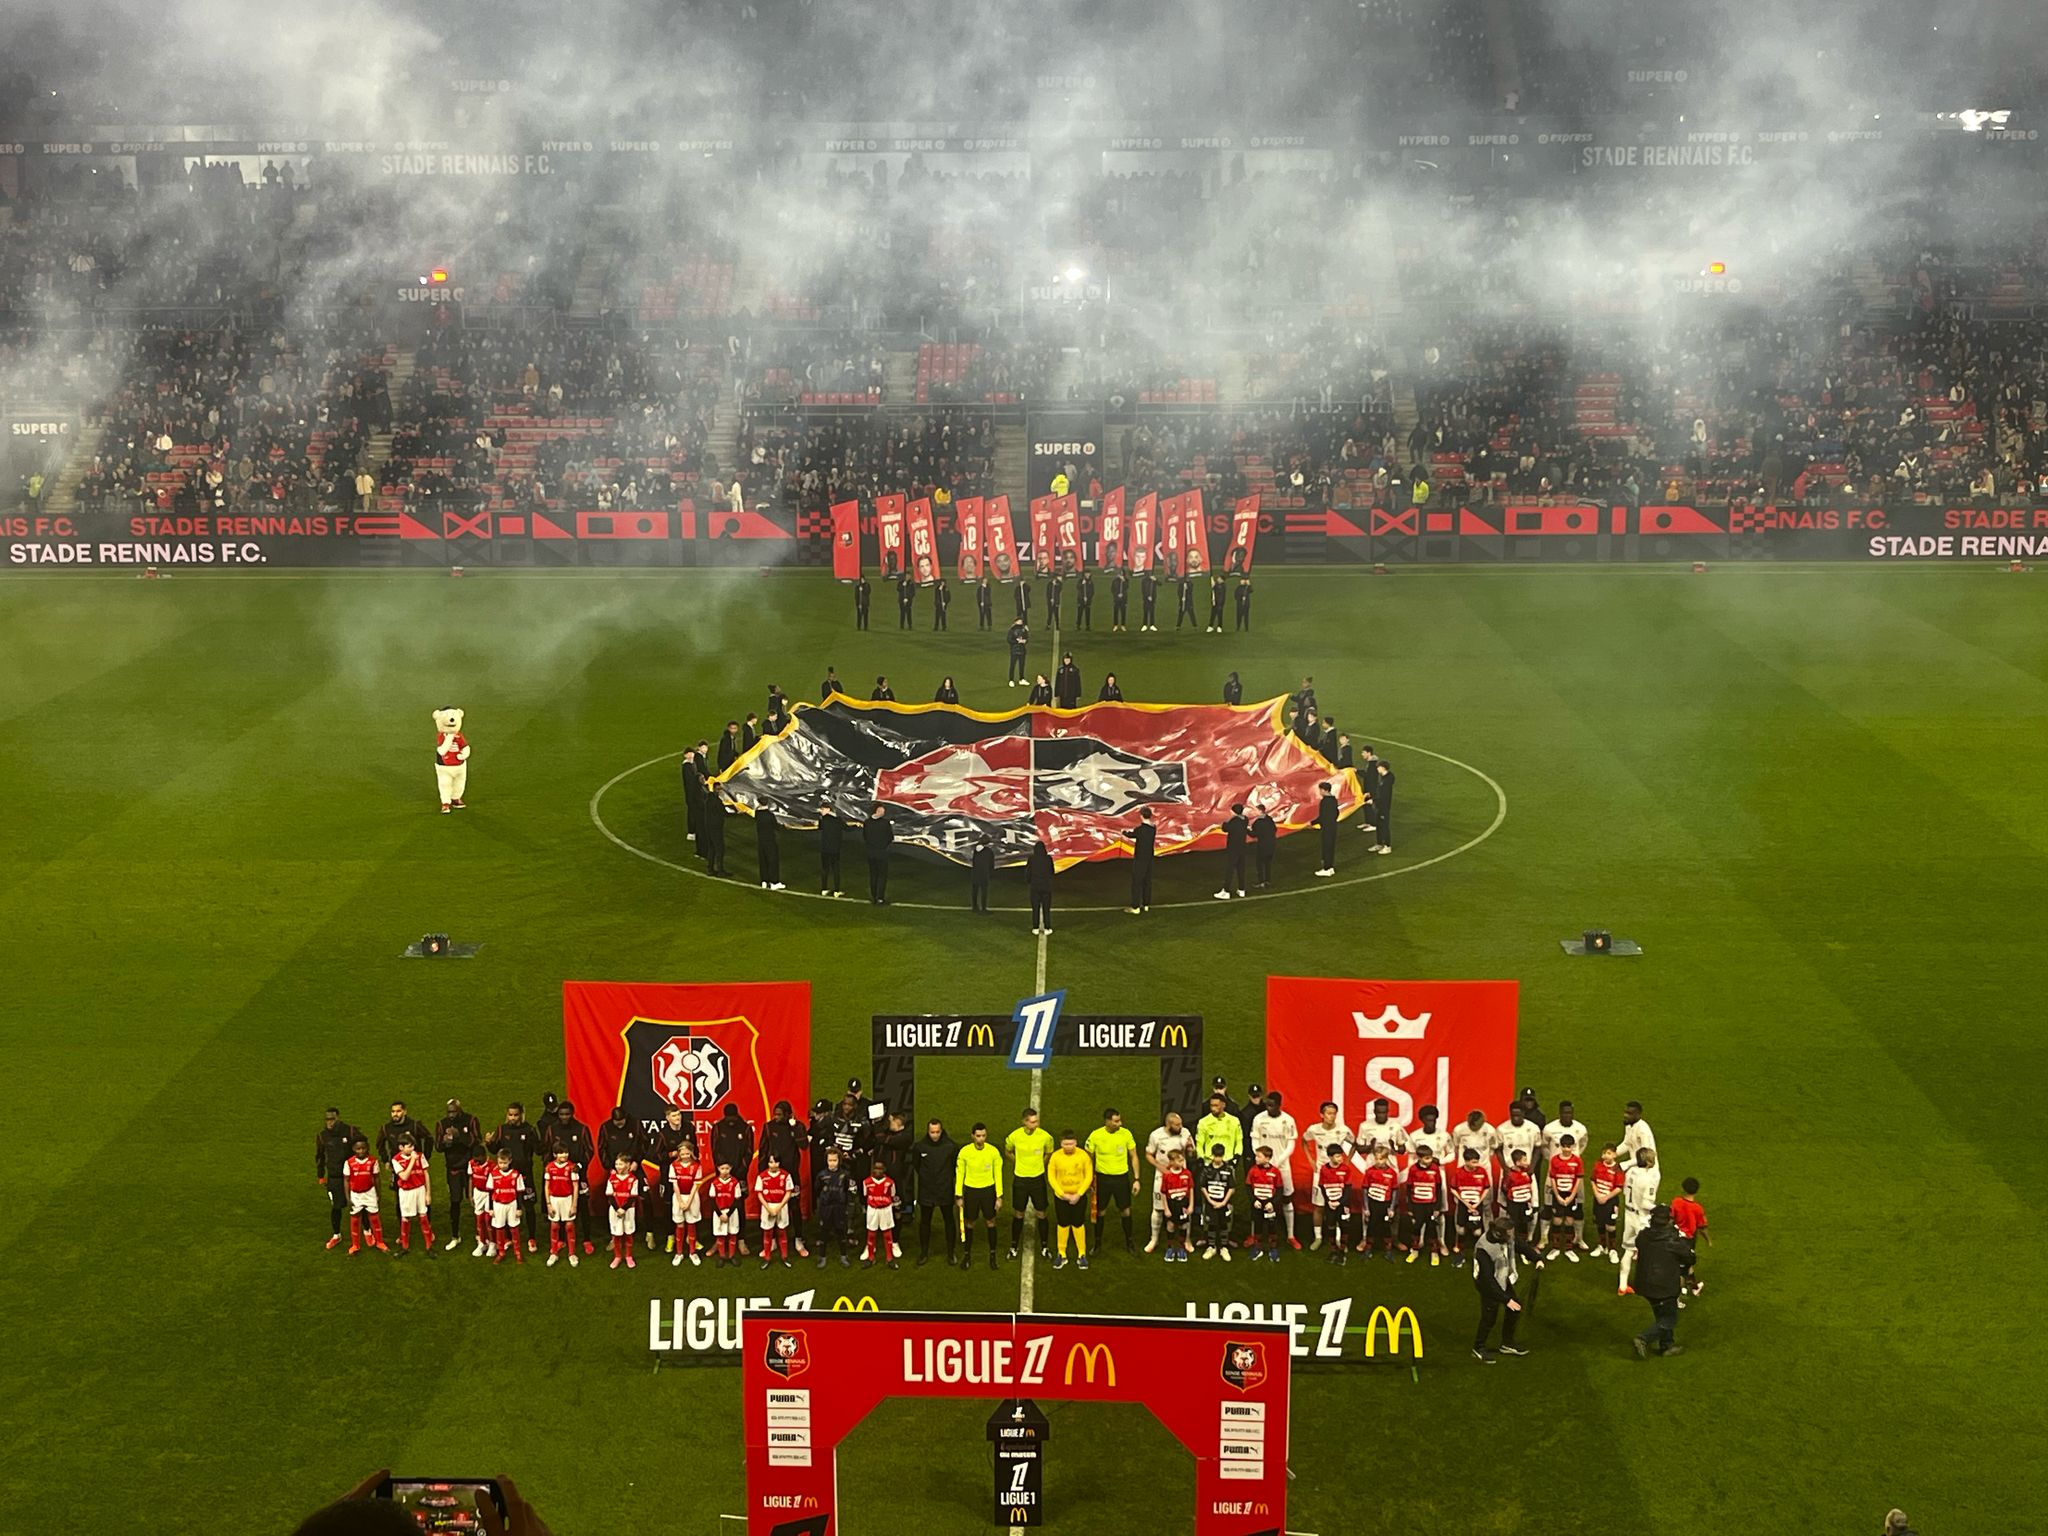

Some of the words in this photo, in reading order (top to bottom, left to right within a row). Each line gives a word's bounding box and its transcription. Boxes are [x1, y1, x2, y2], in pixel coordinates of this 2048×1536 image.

[1628, 70, 1673, 82] SUPER
[1399, 135, 1438, 145] HYPER
[1468, 135, 1507, 145] SUPER
[1550, 132, 1593, 143] express
[1986, 130, 2026, 140] HYPER
[43, 143, 81, 154] SUPER
[258, 142, 295, 152] HYPER
[542, 141, 580, 151] HYPER
[826, 140, 864, 150] HYPER
[895, 140, 932, 150] SUPER
[1112, 138, 1150, 148] HYPER
[1181, 138, 1219, 148] SUPER
[1582, 147, 1637, 166] STADE
[1643, 146, 1722, 166] RENNAIS
[1727, 145, 1758, 165] F.C.
[382, 155, 436, 175] STADE
[441, 155, 519, 175] RENNAIS
[525, 155, 555, 175] F.C.
[398, 287, 451, 301] SUPER
[12, 423, 58, 434] SUPER
[1034, 443, 1081, 455] SUPER
[1847, 511, 1890, 529] F.C.
[1944, 510, 2025, 528] STADE
[35, 517, 78, 536] F.C.
[130, 517, 208, 536] STADE
[217, 517, 328, 535] RENNAIS
[1869, 536, 1954, 556] STADE
[10, 543, 91, 563] STADE
[99, 543, 215, 563] RENNAIS
[222, 542, 267, 562] F.C.
[886, 1023, 942, 1048] LIGUE
[1078, 1023, 1135, 1048] LIGUE
[903, 1338, 1014, 1384] LIGUE
[770, 1394, 796, 1403] PUMA
[1224, 1406, 1251, 1416] PUMA
[771, 1433, 797, 1442] PUMA
[1000, 1428, 1018, 1438] LIGUE
[1223, 1445, 1250, 1454] PUMA
[763, 1495, 792, 1508] LIGUE
[1000, 1492, 1030, 1505] LIGUE
[1031, 1492, 1036, 1505] 1
[1213, 1501, 1242, 1515] LIGUE
